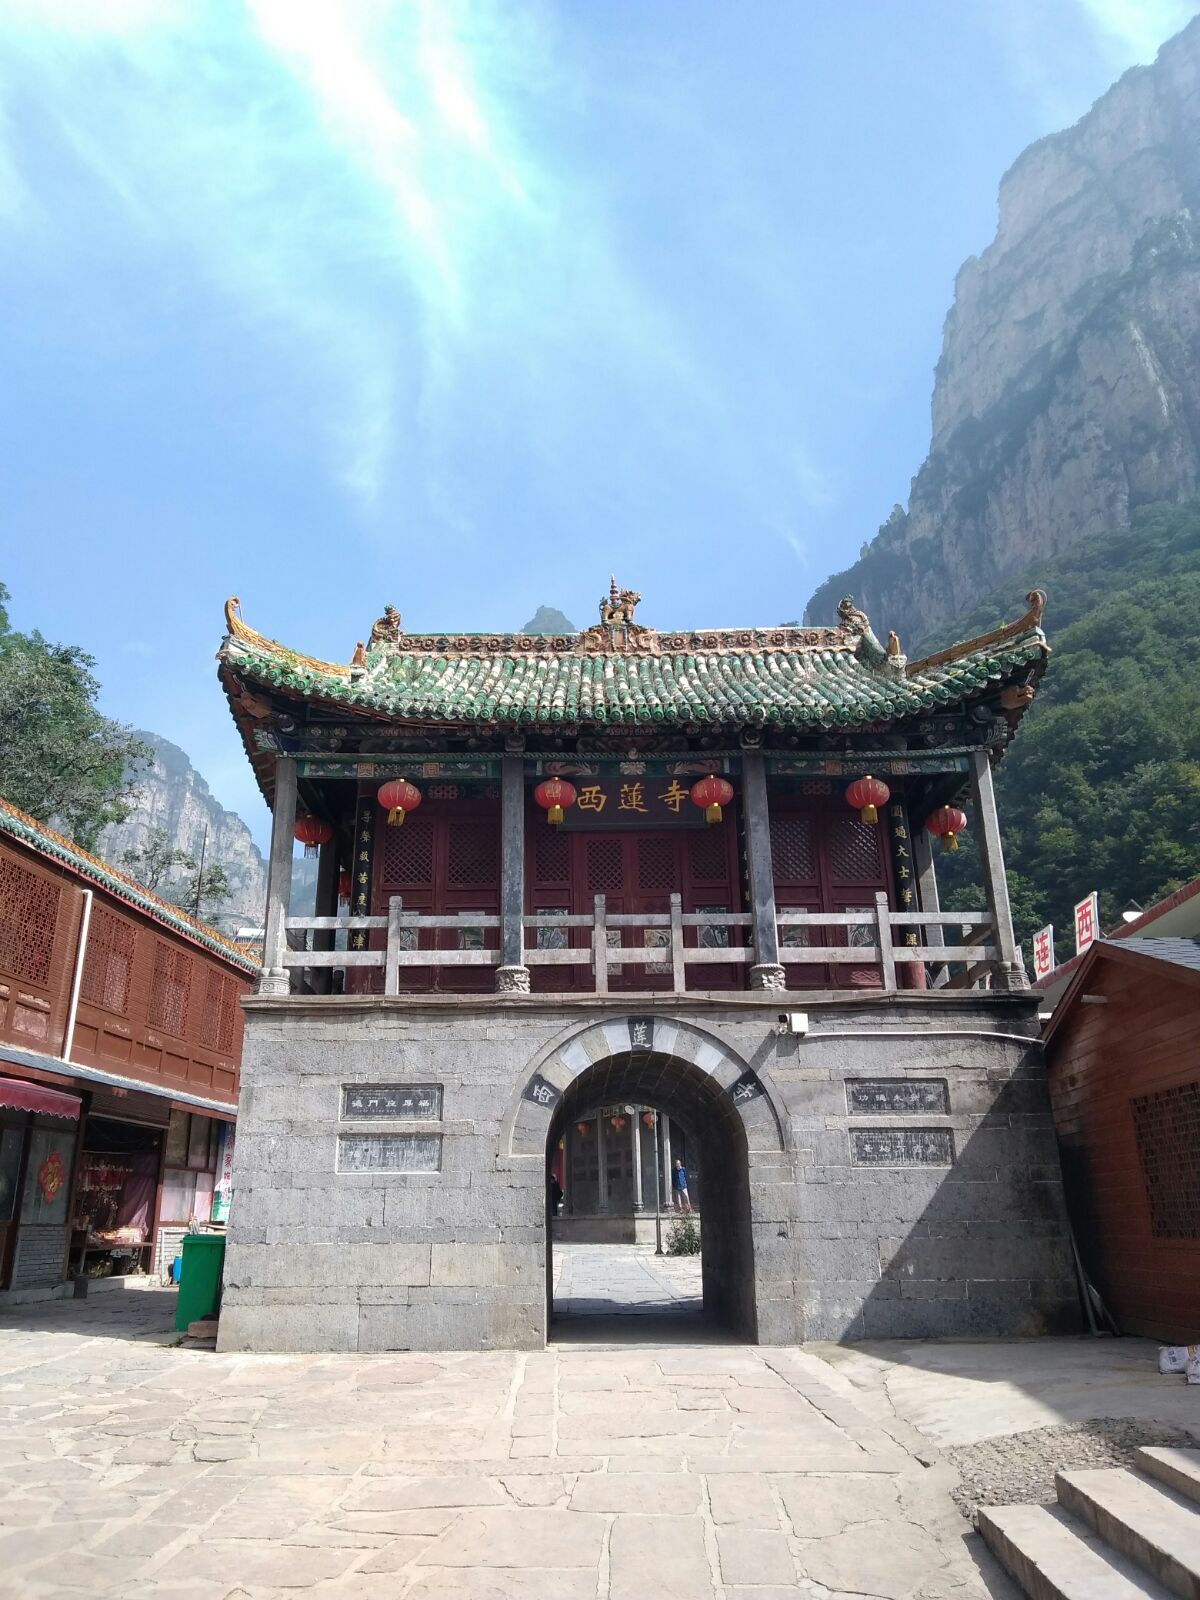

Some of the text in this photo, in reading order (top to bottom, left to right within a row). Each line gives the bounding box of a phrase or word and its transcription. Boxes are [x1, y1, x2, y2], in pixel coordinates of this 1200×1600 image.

[578, 780, 689, 812] 西蓮寺
[353, 810, 372, 950] 尋聲救苦度津
[891, 805, 918, 946] 圓通大士誓深
[1077, 900, 1093, 947] 西
